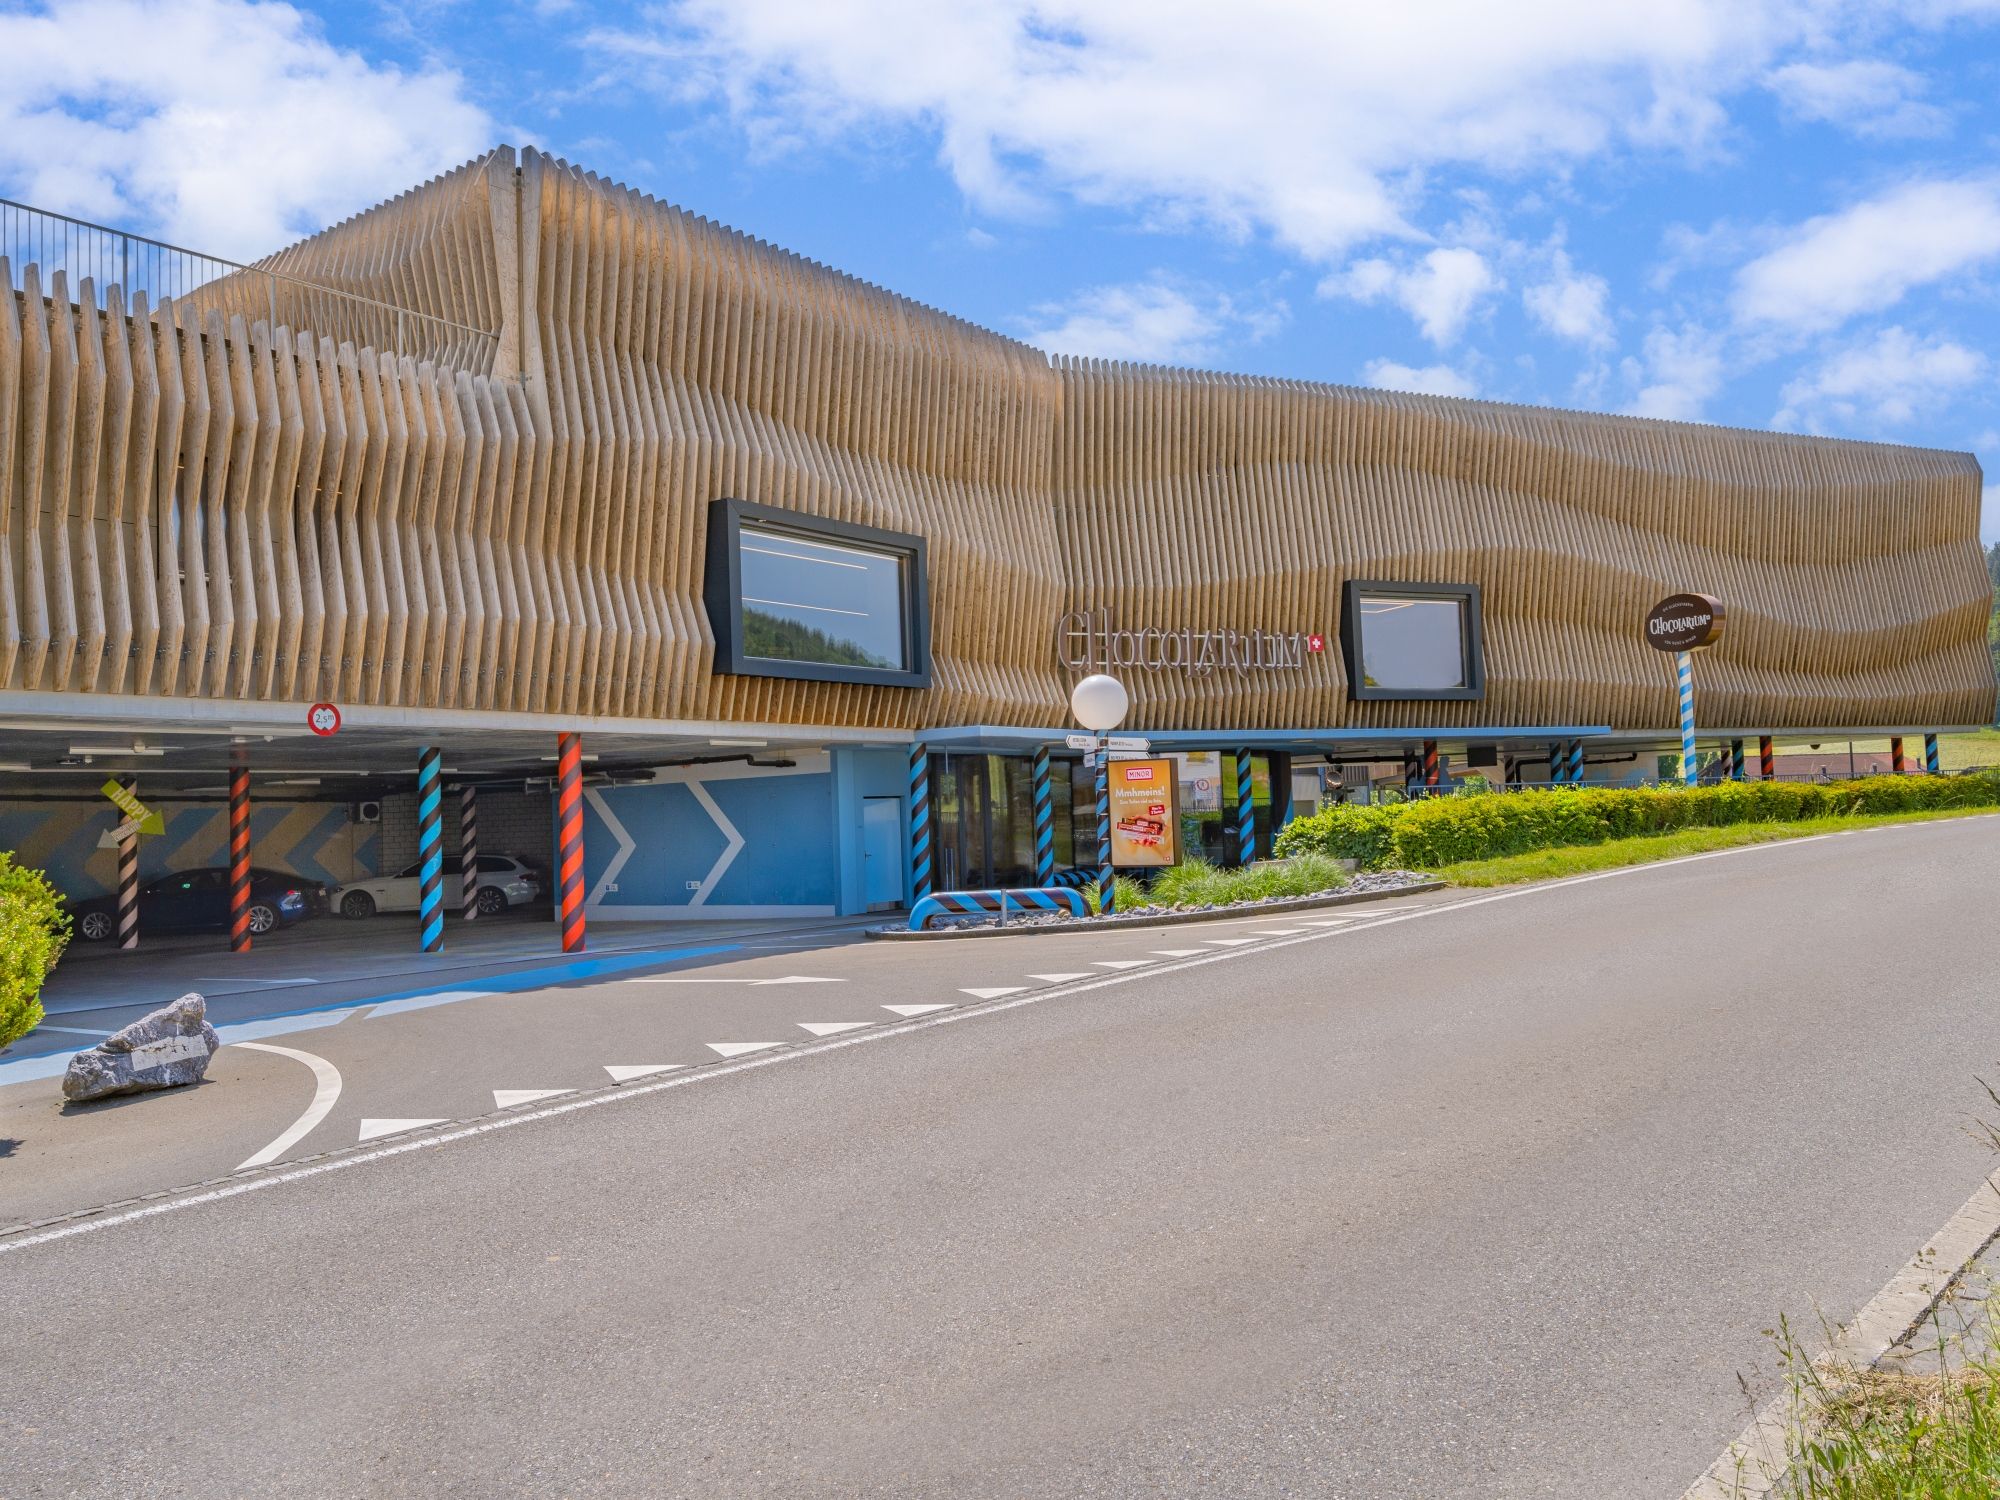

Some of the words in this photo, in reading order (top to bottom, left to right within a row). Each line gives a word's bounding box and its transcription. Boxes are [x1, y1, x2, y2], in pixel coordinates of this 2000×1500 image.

[1649, 614, 1708, 635] CHOCOLARIUM
[1058, 606, 1307, 678] CHOCOLARIUM
[112, 787, 152, 821] HAPPY
[1115, 786, 1165, 797] Mmhmeins!
